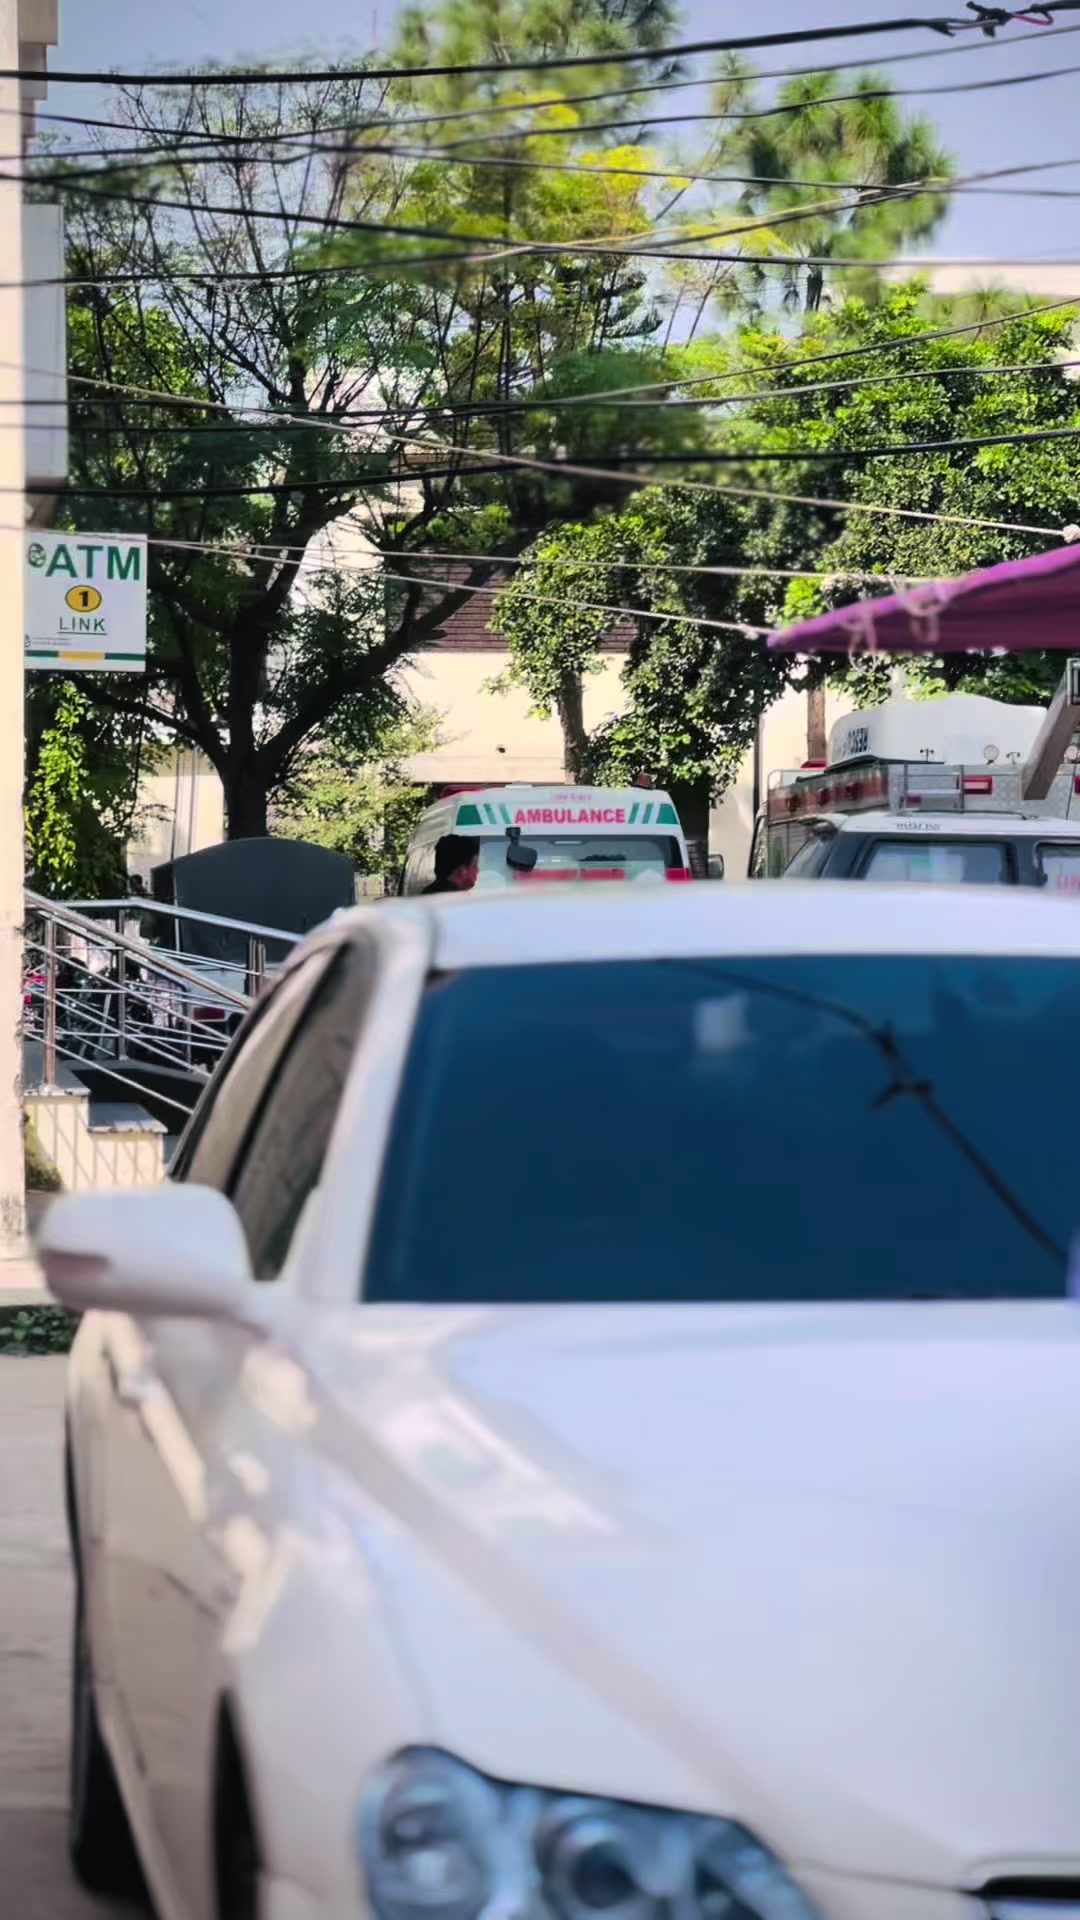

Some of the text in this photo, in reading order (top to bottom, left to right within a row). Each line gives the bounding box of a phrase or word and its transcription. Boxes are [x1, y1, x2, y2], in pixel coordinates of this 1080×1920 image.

[45, 544, 141, 580] ATM
[78, 590, 90, 608] 1
[59, 617, 106, 632] LINK
[514, 808, 626, 824] AMBULANCE
